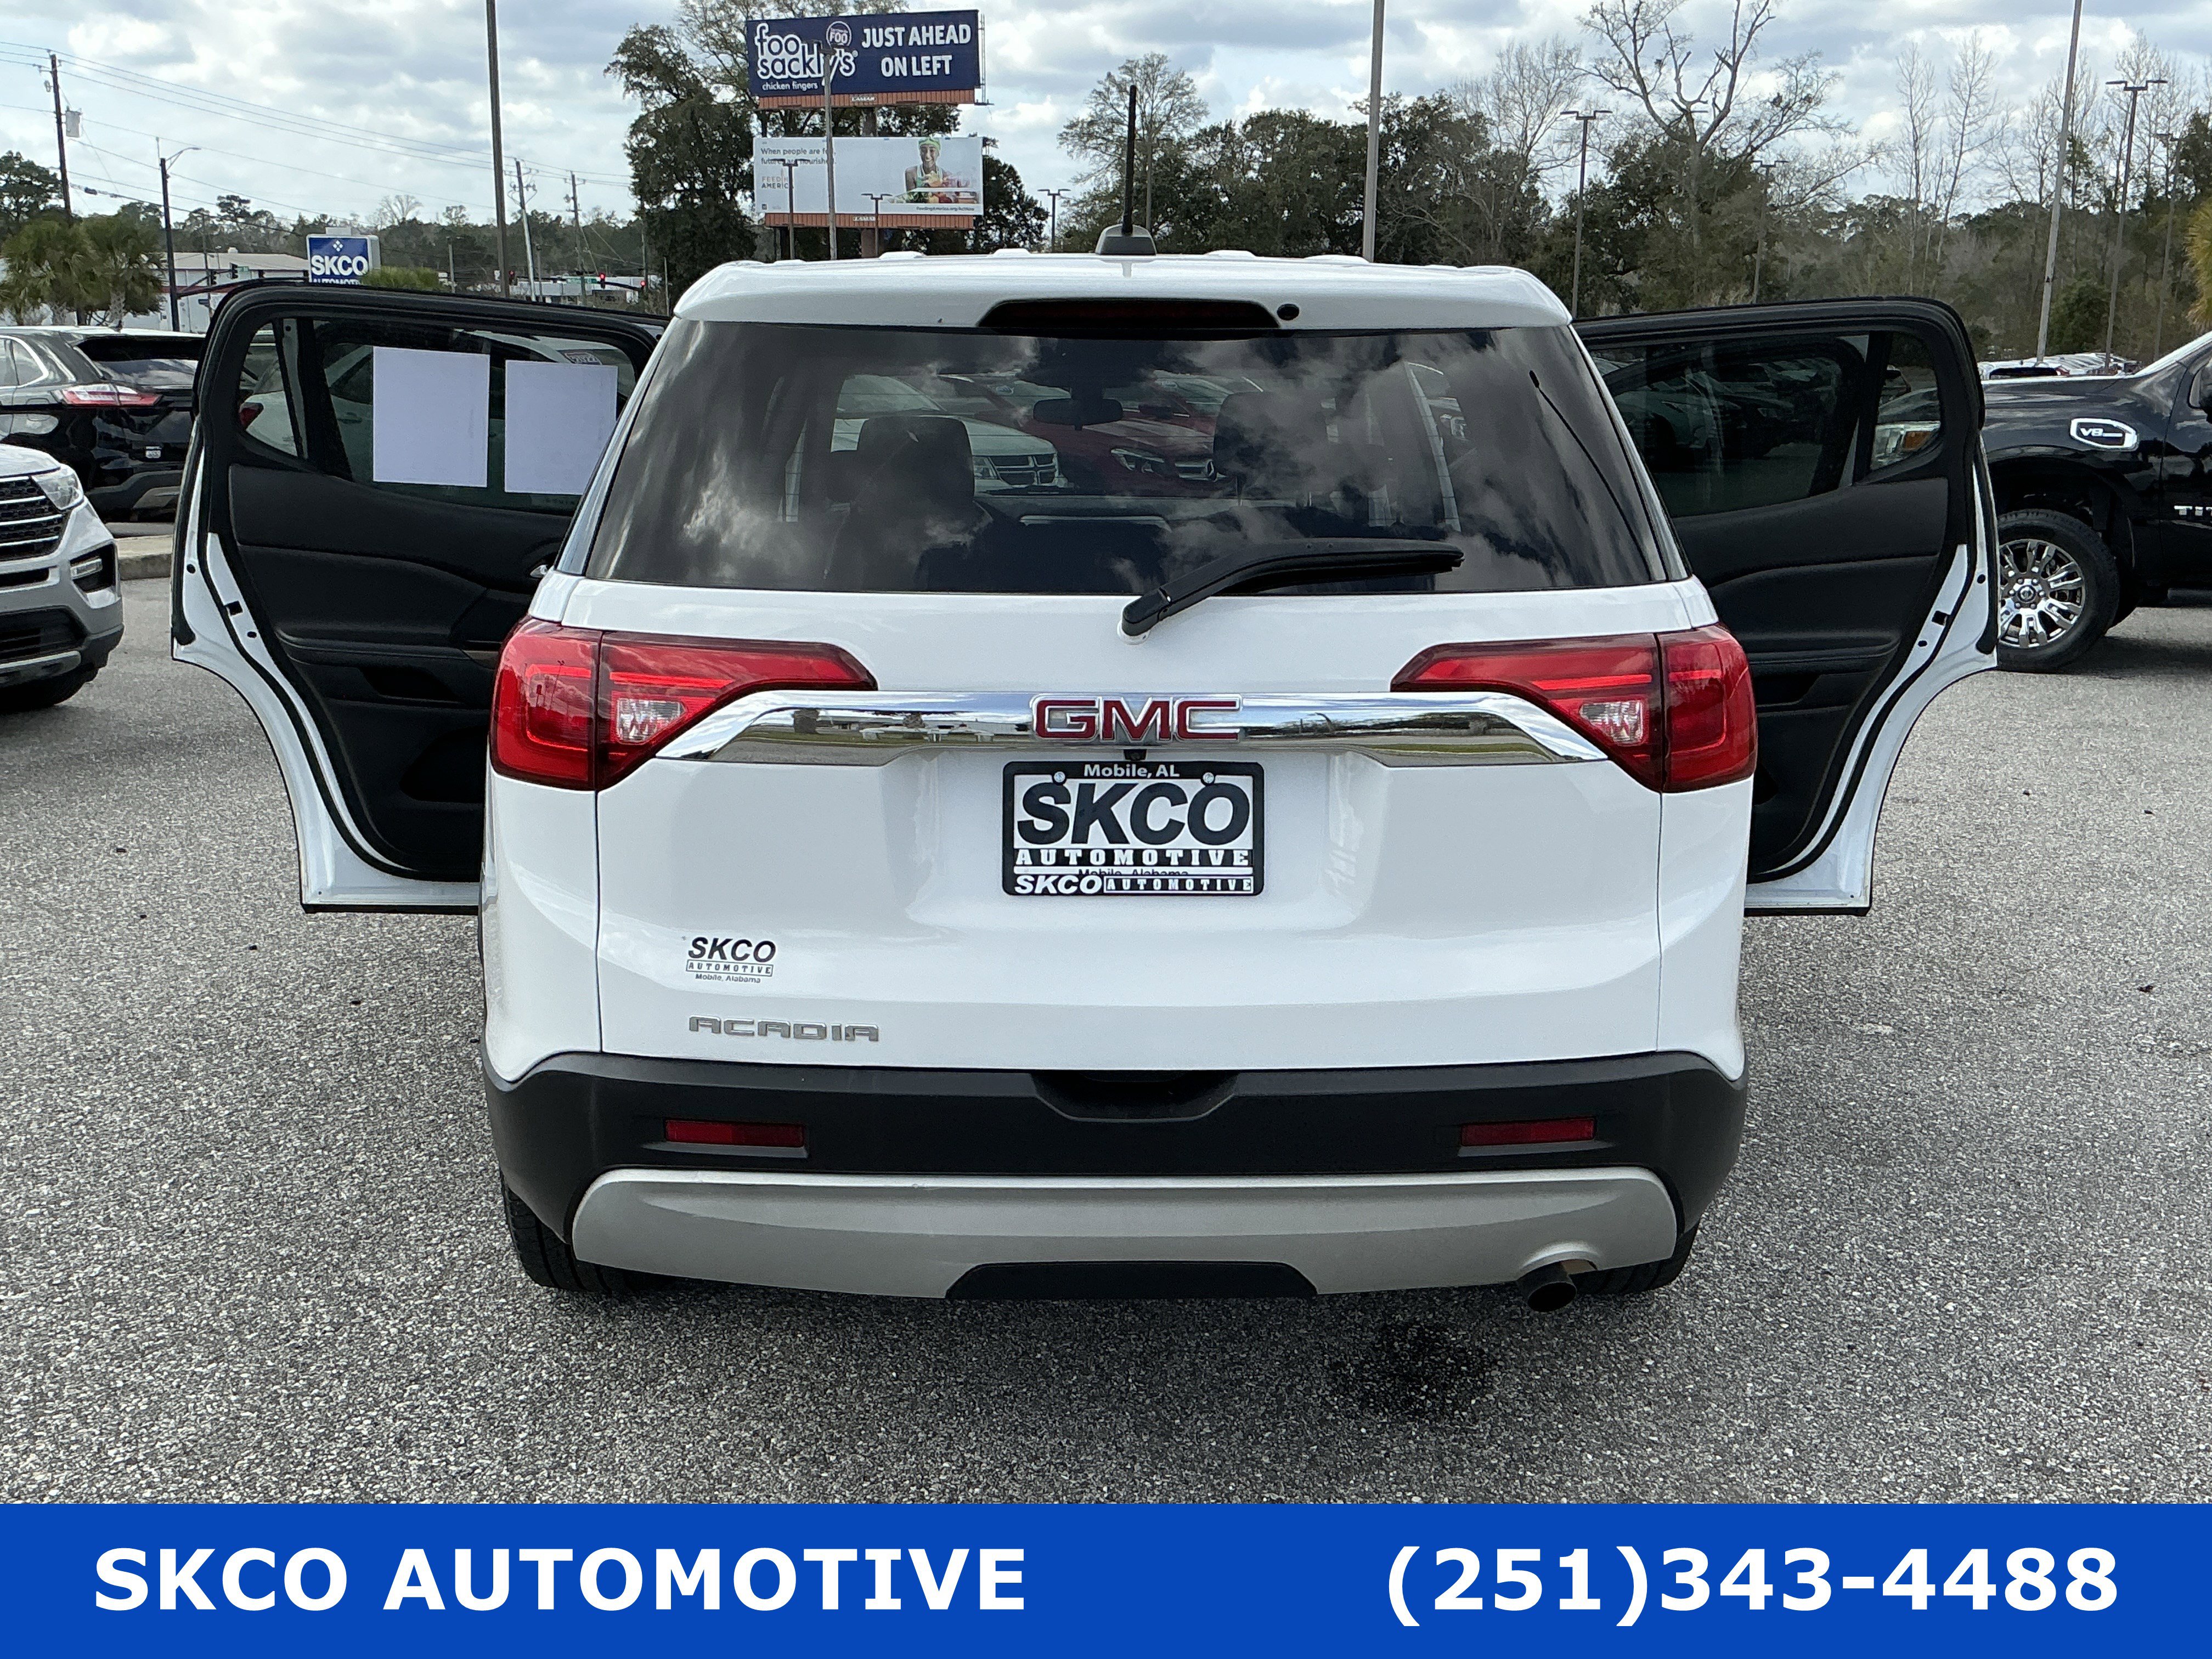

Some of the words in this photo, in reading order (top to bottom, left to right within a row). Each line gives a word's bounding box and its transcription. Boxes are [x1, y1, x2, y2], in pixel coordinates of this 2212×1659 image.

[862, 27, 905, 48] JUST
[908, 24, 971, 46] AHEAD
[881, 57, 907, 77] ON
[911, 55, 952, 76] LEFT
[762, 82, 791, 91] chicken
[792, 81, 819, 92] fingers
[311, 255, 369, 276] SKCO
[2080, 428, 2103, 437] V8
[1031, 695, 1241, 741] GMC
[1084, 764, 1152, 778] Mobile,
[1155, 765, 1180, 777] AL
[1017, 782, 1250, 846] SKCO
[1016, 849, 1249, 866] AUTOMOTIVE
[1014, 875, 1103, 894] SKCO
[1106, 878, 1252, 891] AUTOMOTIVE
[688, 936, 776, 963] SKCO
[688, 962, 772, 974] AUTOMOTIVE
[695, 973, 724, 982] Mobile,
[725, 975, 761, 984] Alabama
[689, 1014, 879, 1042] ACADIA
